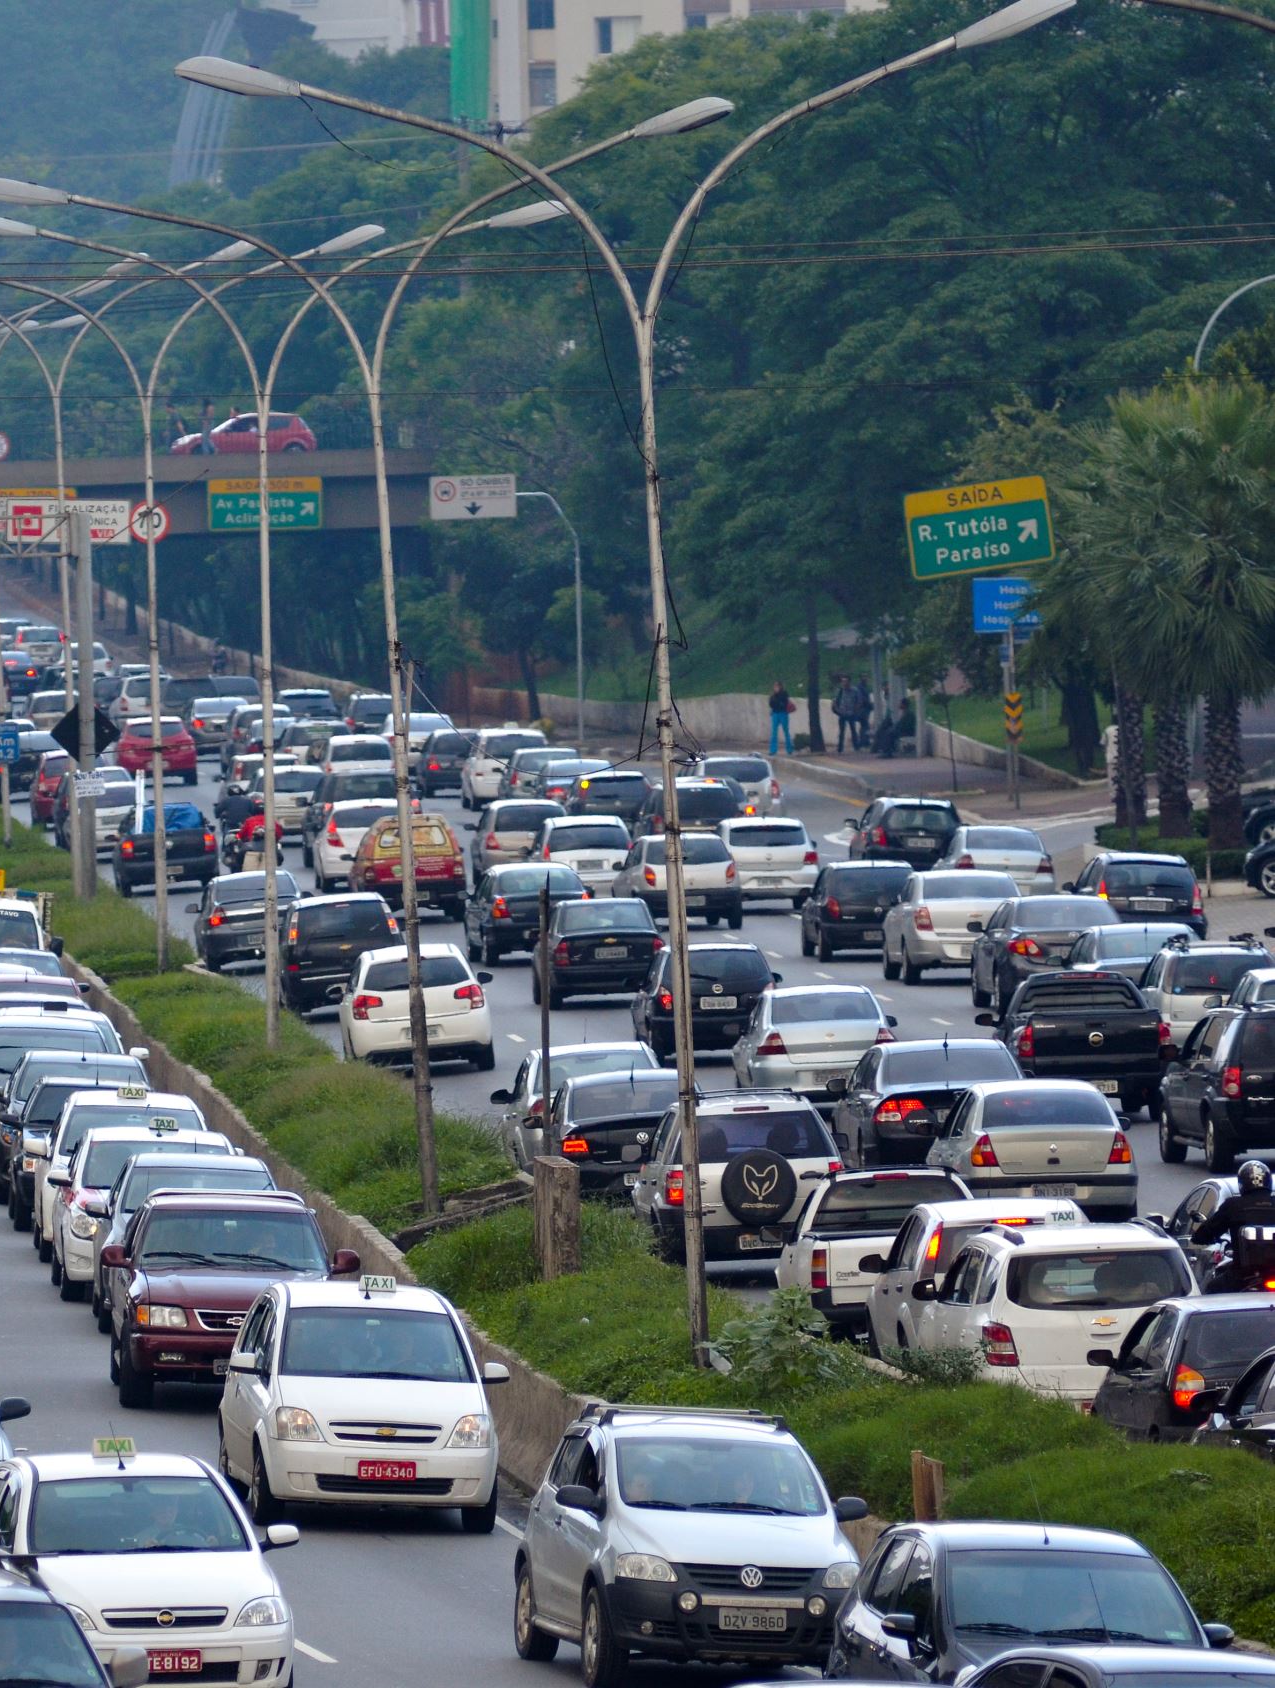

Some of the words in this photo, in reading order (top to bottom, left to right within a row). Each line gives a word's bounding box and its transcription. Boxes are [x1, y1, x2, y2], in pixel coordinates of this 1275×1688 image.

[239, 497, 295, 508] Paista
[946, 486, 1003, 507] SAÍDA
[47, 504, 126, 514] FICALIZAÇÃO
[917, 524, 938, 542] R.
[944, 516, 1008, 538] Tutóia
[935, 542, 1011, 565] Paraíso
[121, 1087, 144, 1097] TAXI
[154, 1119, 175, 1129] TAXI
[1051, 1212, 1075, 1222] TAXI
[364, 1276, 393, 1289] TAXI
[97, 1439, 132, 1452] TAXI
[148, 1657, 198, 1670] TE-8192
